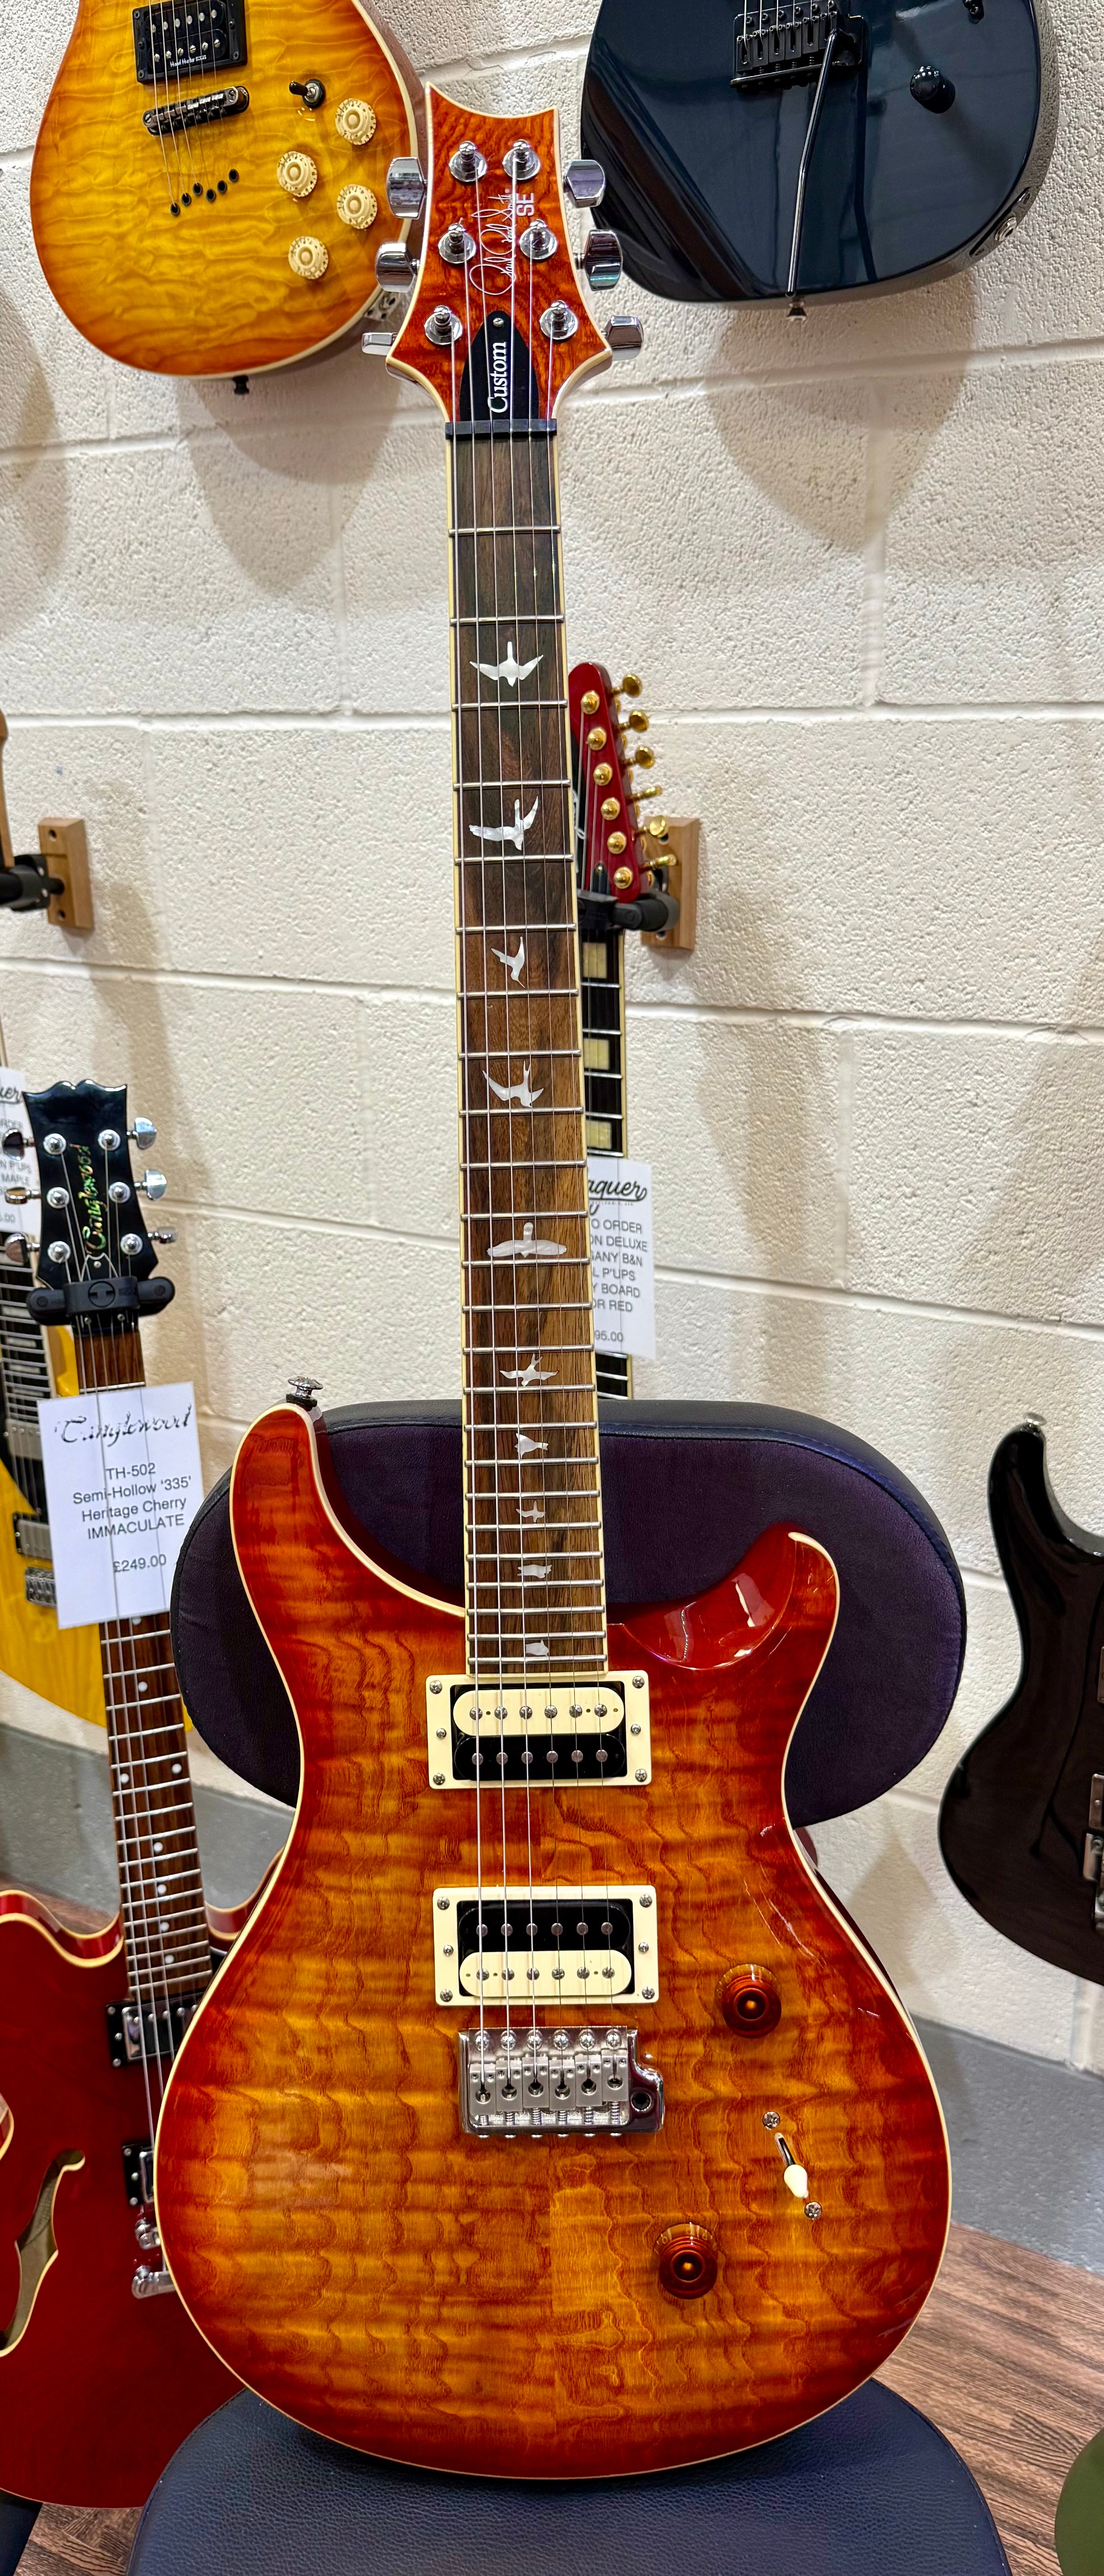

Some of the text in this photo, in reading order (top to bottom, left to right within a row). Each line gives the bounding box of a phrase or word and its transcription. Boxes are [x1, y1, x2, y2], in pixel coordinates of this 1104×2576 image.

[516, 192, 534, 216] SE
[487, 341, 508, 413] Custom
[603, 1219, 642, 1234] ORDER
[606, 1235, 648, 1252] DELUXE
[591, 1251, 643, 1267] ANY B&N
[602, 1267, 636, 1282] P'UPS
[601, 1283, 640, 1298] BOARD
[609, 1299, 633, 1312] RED
[106, 1462, 156, 1480] TH-502
[73, 1483, 156, 1504] Semi-Hollow
[82, 1497, 187, 1522] Heritage Cherry
[87, 1513, 185, 1540] IMMACULATE
[112, 1553, 167, 1573] £249.00
